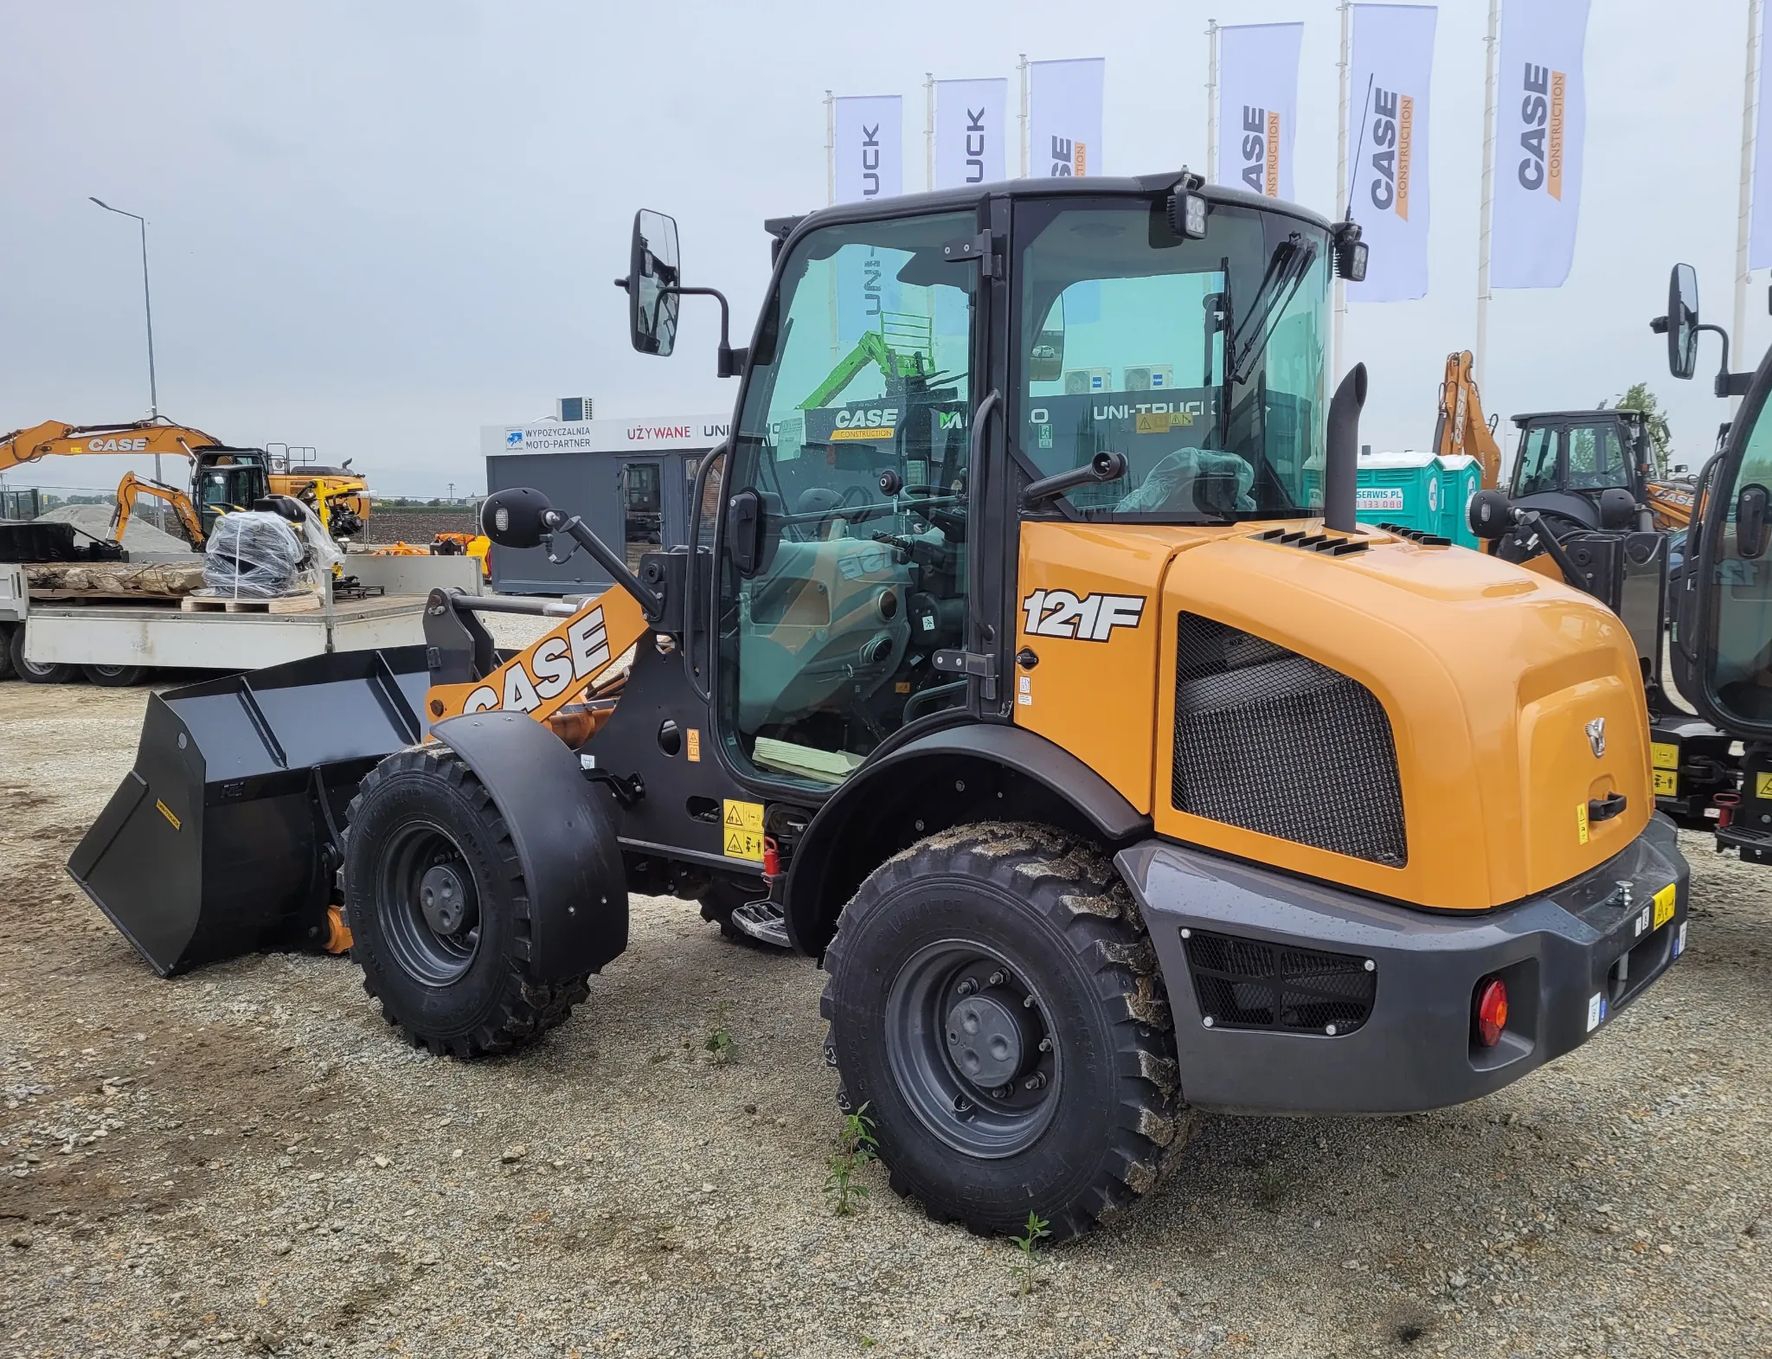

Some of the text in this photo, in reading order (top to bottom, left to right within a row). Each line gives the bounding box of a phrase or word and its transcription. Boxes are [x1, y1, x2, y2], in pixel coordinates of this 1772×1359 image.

[966, 106, 984, 183] UCK
[1371, 87, 1397, 210] CASE
[1399, 99, 1411, 199] CONSTRUCTION
[1518, 63, 1548, 190] CASE
[1551, 76, 1563, 178] CONSTRUCTION
[88, 438, 148, 451] CASE
[525, 438, 591, 449] MOTO-PARTNER
[627, 425, 691, 440] UŻYWANE
[835, 409, 898, 428] CASE
[840, 430, 892, 438] CONSTRUCTION
[1023, 588, 1147, 643] 121F
[462, 605, 611, 714] CASE
